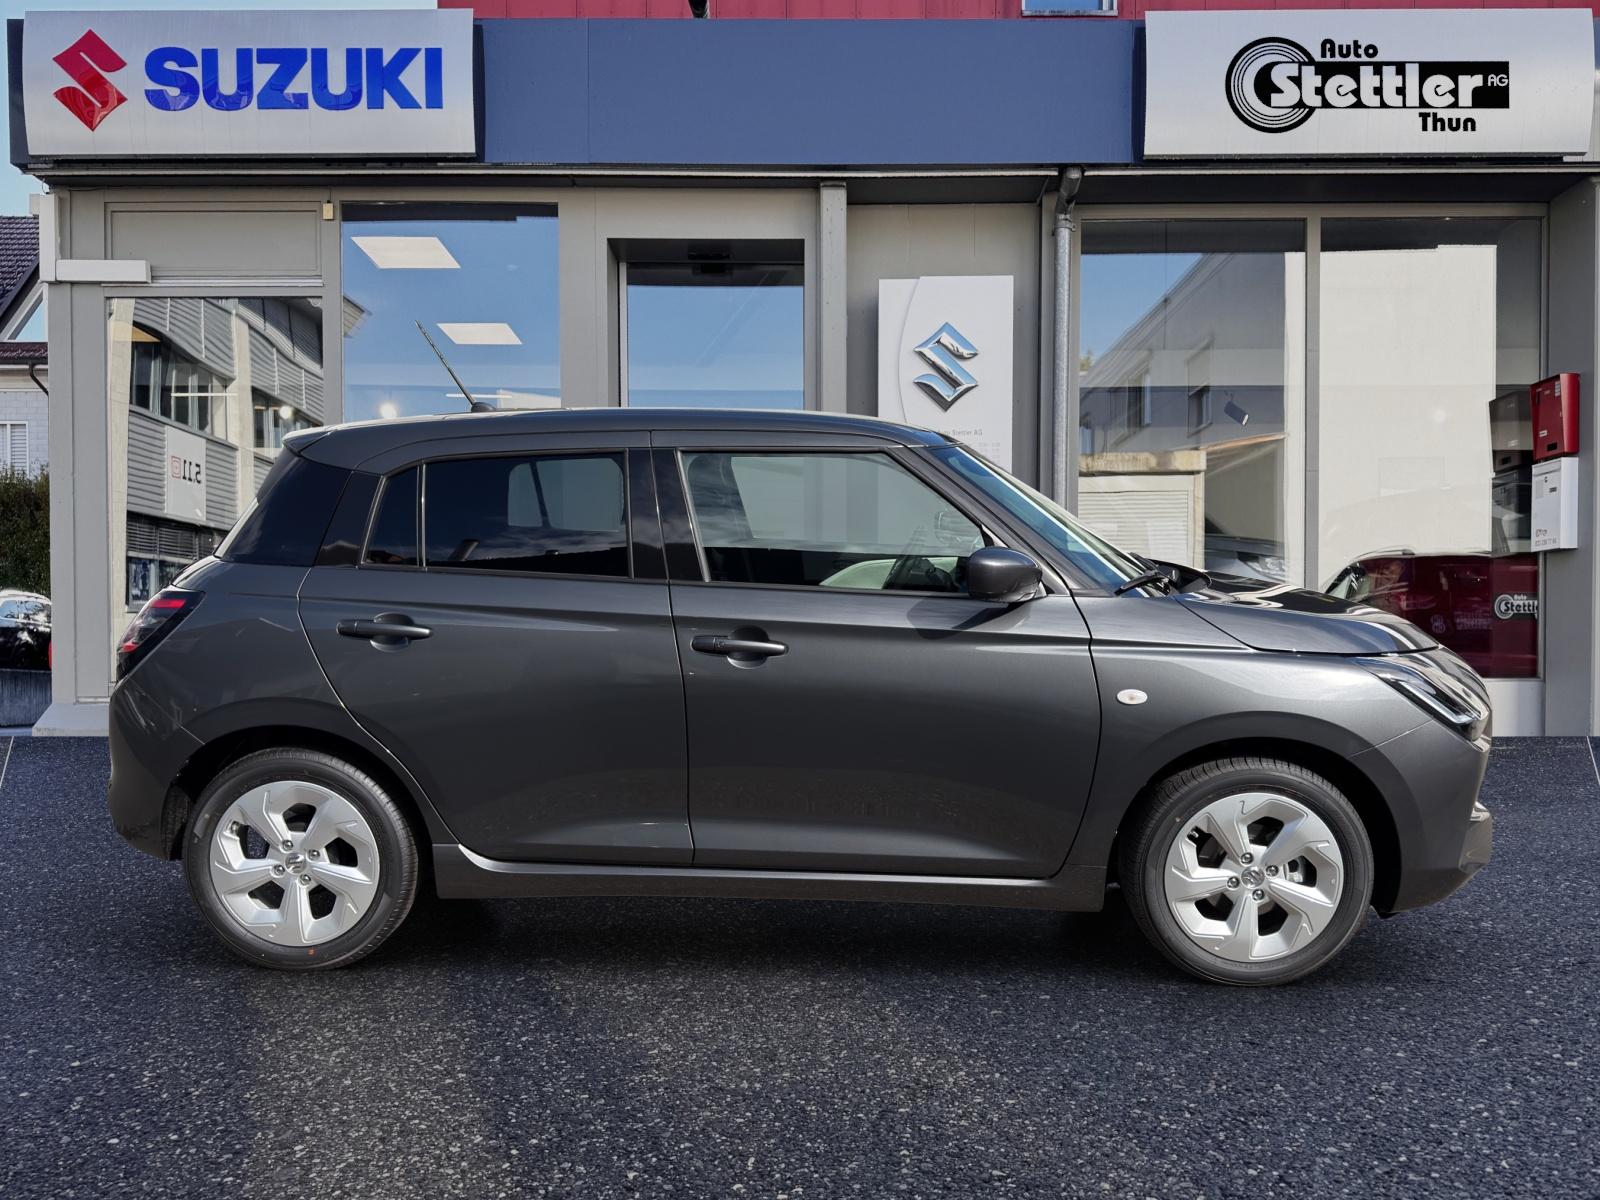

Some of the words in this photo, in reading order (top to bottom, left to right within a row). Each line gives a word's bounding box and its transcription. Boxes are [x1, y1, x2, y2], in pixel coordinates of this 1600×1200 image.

[1320, 38, 1379, 59] Auto
[144, 46, 443, 111] SUZUKI
[1270, 62, 1484, 108] Stettler
[1487, 74, 1509, 87] AG
[1418, 111, 1477, 132] Thun
